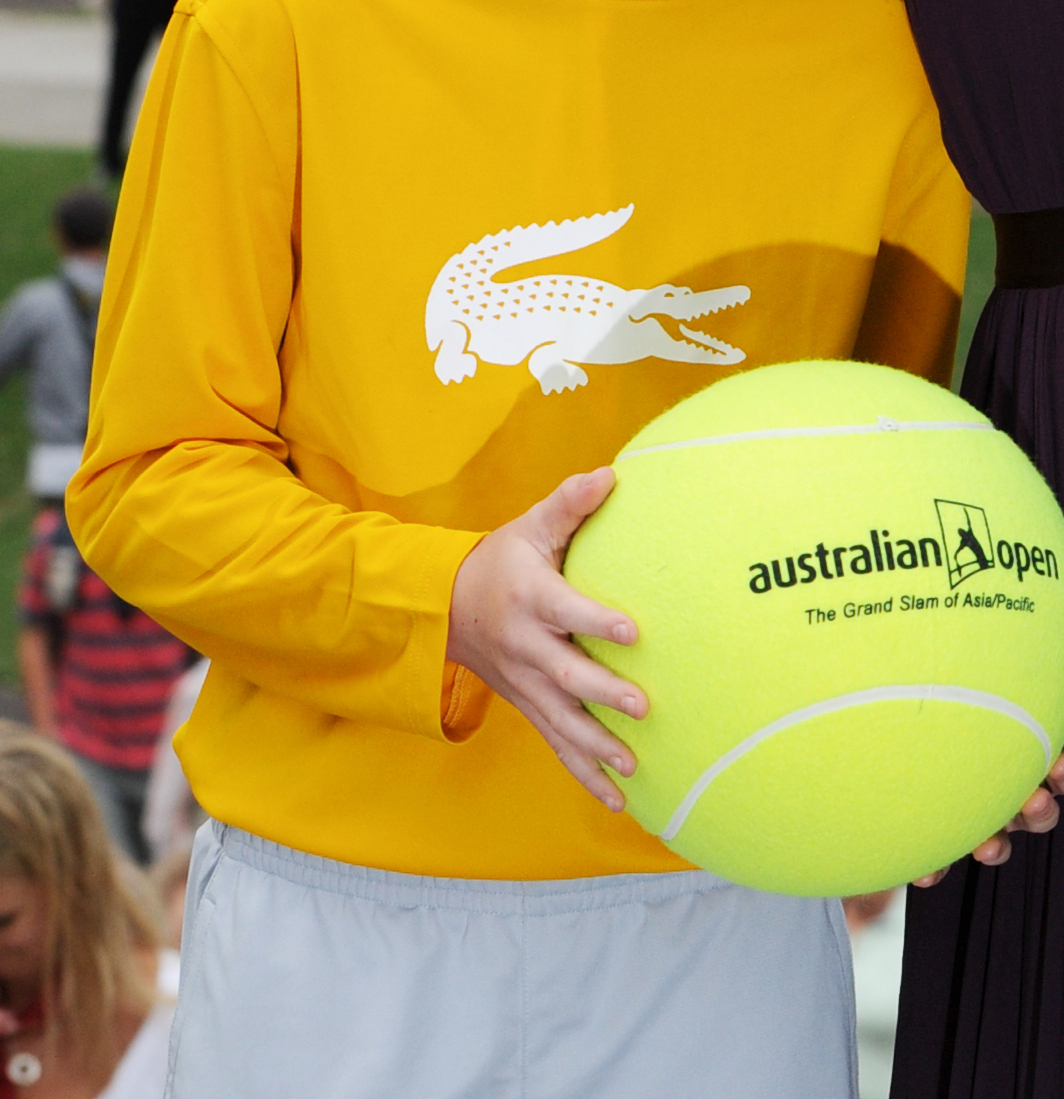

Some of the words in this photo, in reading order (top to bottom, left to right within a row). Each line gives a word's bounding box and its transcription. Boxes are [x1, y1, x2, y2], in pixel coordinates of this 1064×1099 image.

[750, 529, 943, 594] australian
[997, 540, 1059, 581] open
[805, 609, 836, 624] The
[843, 598, 893, 618] Grand
[900, 596, 939, 611] Slam
[944, 592, 959, 608] of
[962, 592, 1034, 612] Asia/Pacific
